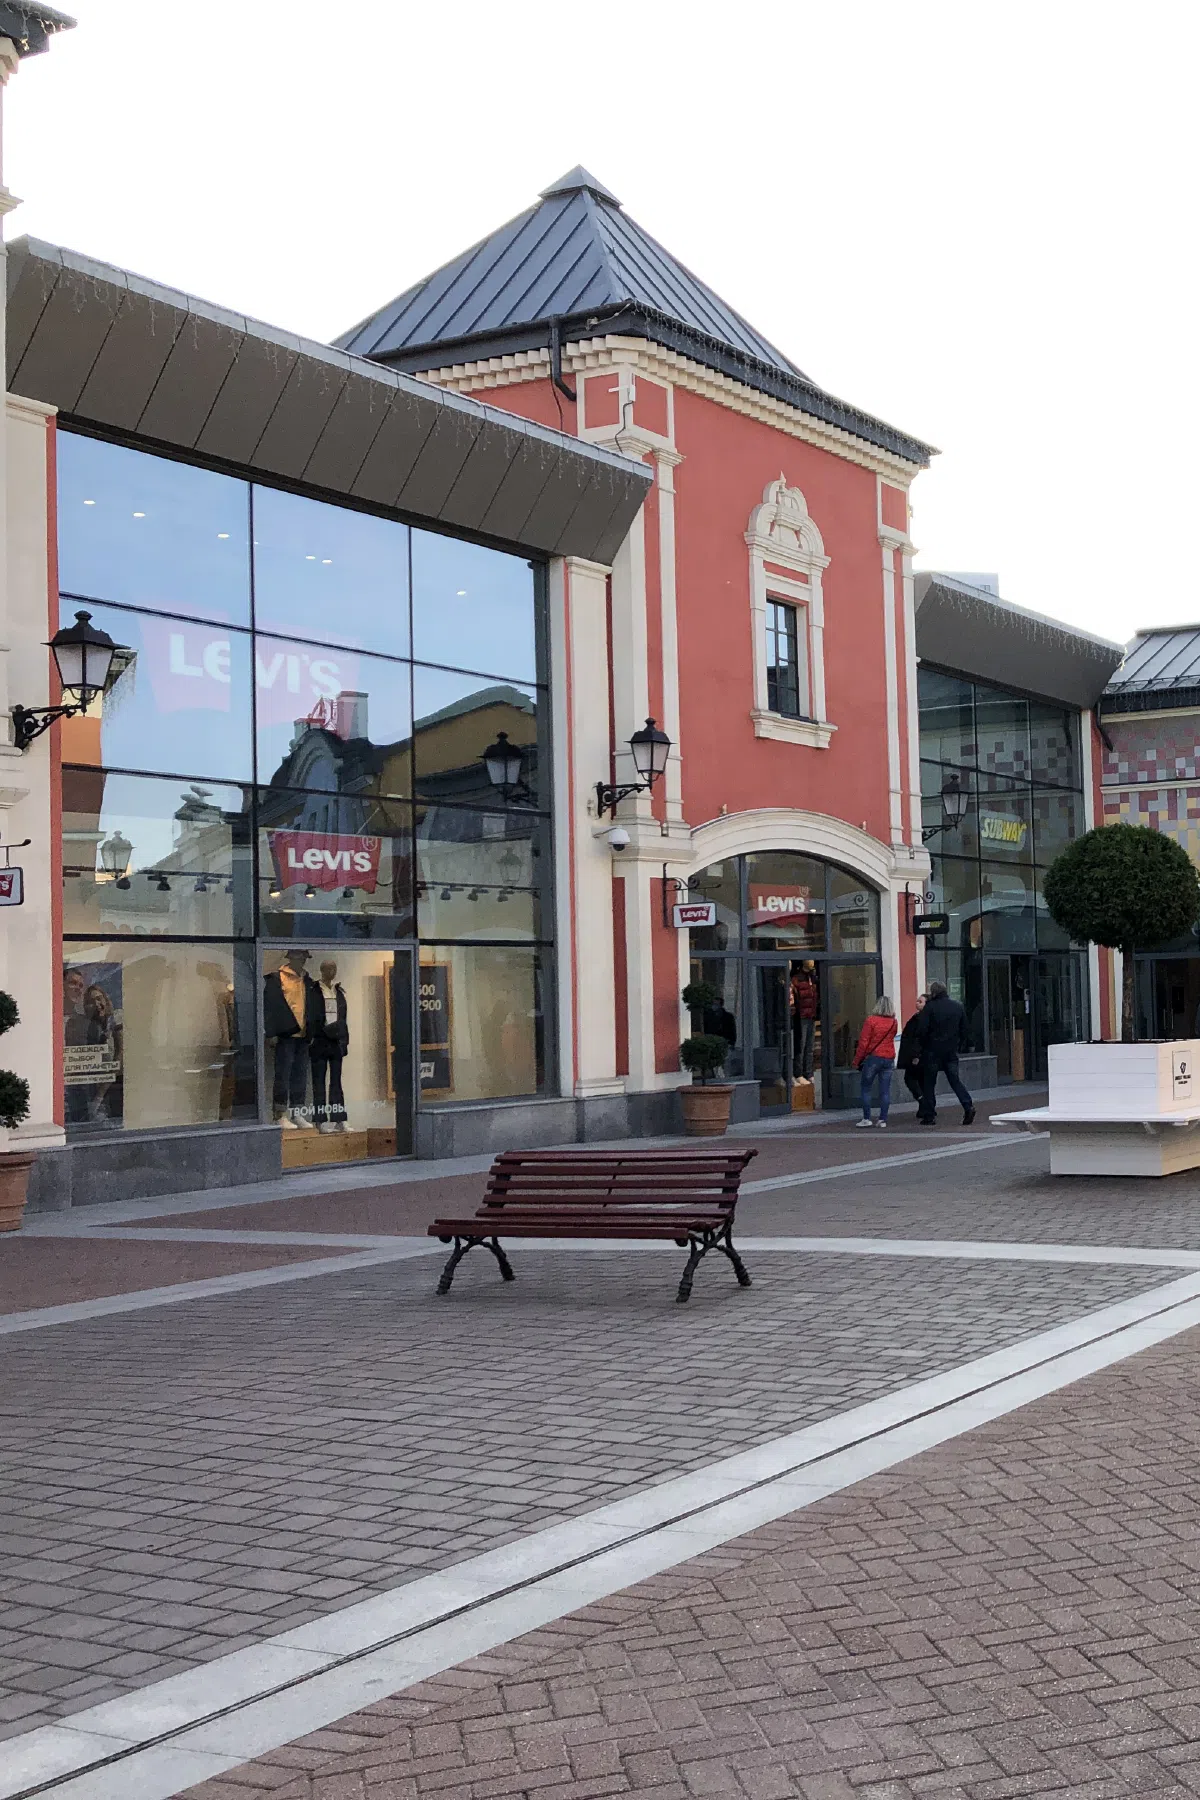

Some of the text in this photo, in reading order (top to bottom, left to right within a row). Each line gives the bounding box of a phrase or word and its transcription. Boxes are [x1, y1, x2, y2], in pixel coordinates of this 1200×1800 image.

[981, 818, 1027, 843] SUBWAY
[287, 847, 372, 872] Levi's
[757, 895, 805, 912] Levi's
[288, 1104, 315, 1117] ТВОЙ
